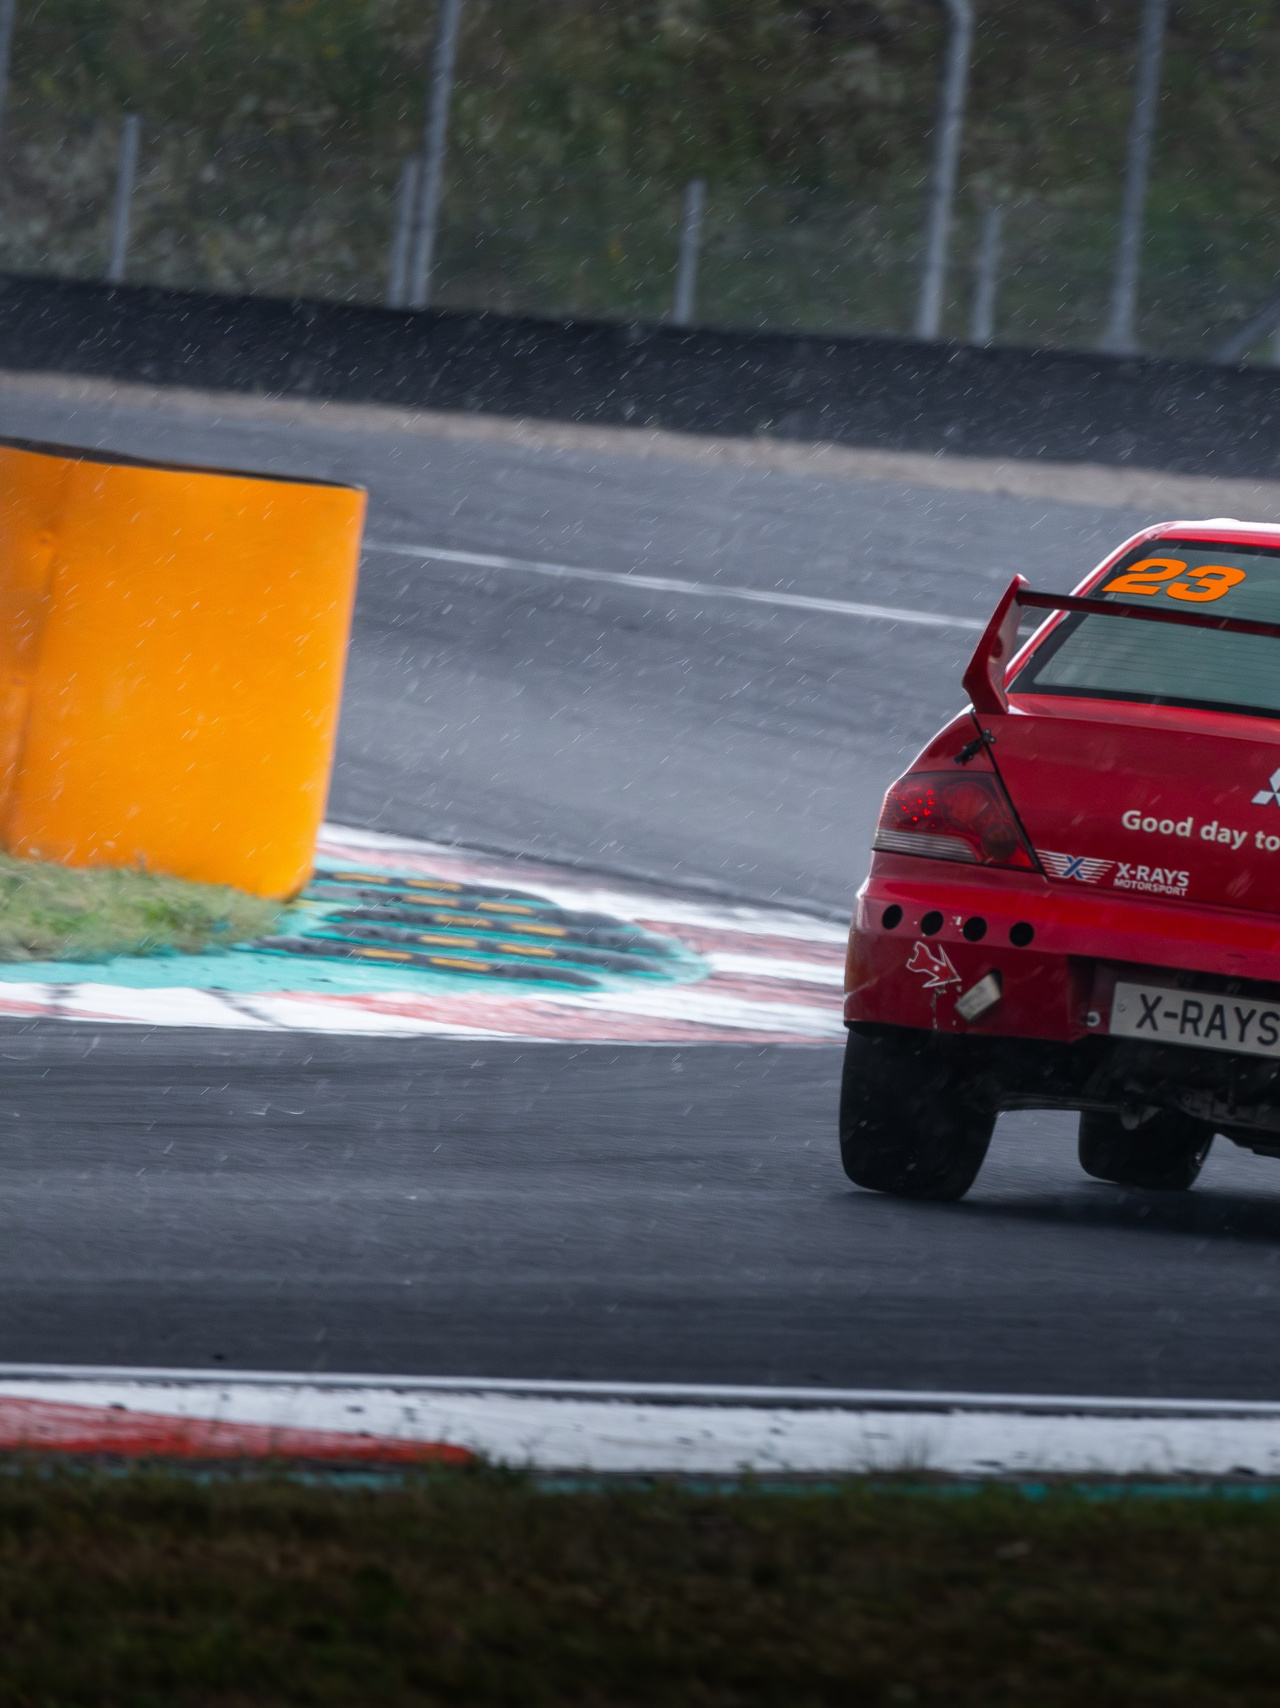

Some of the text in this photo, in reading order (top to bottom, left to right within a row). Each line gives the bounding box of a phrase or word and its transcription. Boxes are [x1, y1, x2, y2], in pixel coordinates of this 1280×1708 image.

[1101, 558, 1246, 601] 23
[1122, 810, 1193, 837] Good
[1200, 820, 1248, 850] day
[1255, 830, 1280, 852] to
[1113, 878, 1188, 896] MOTORSPORT
[1115, 862, 1190, 887] X-RAYS
